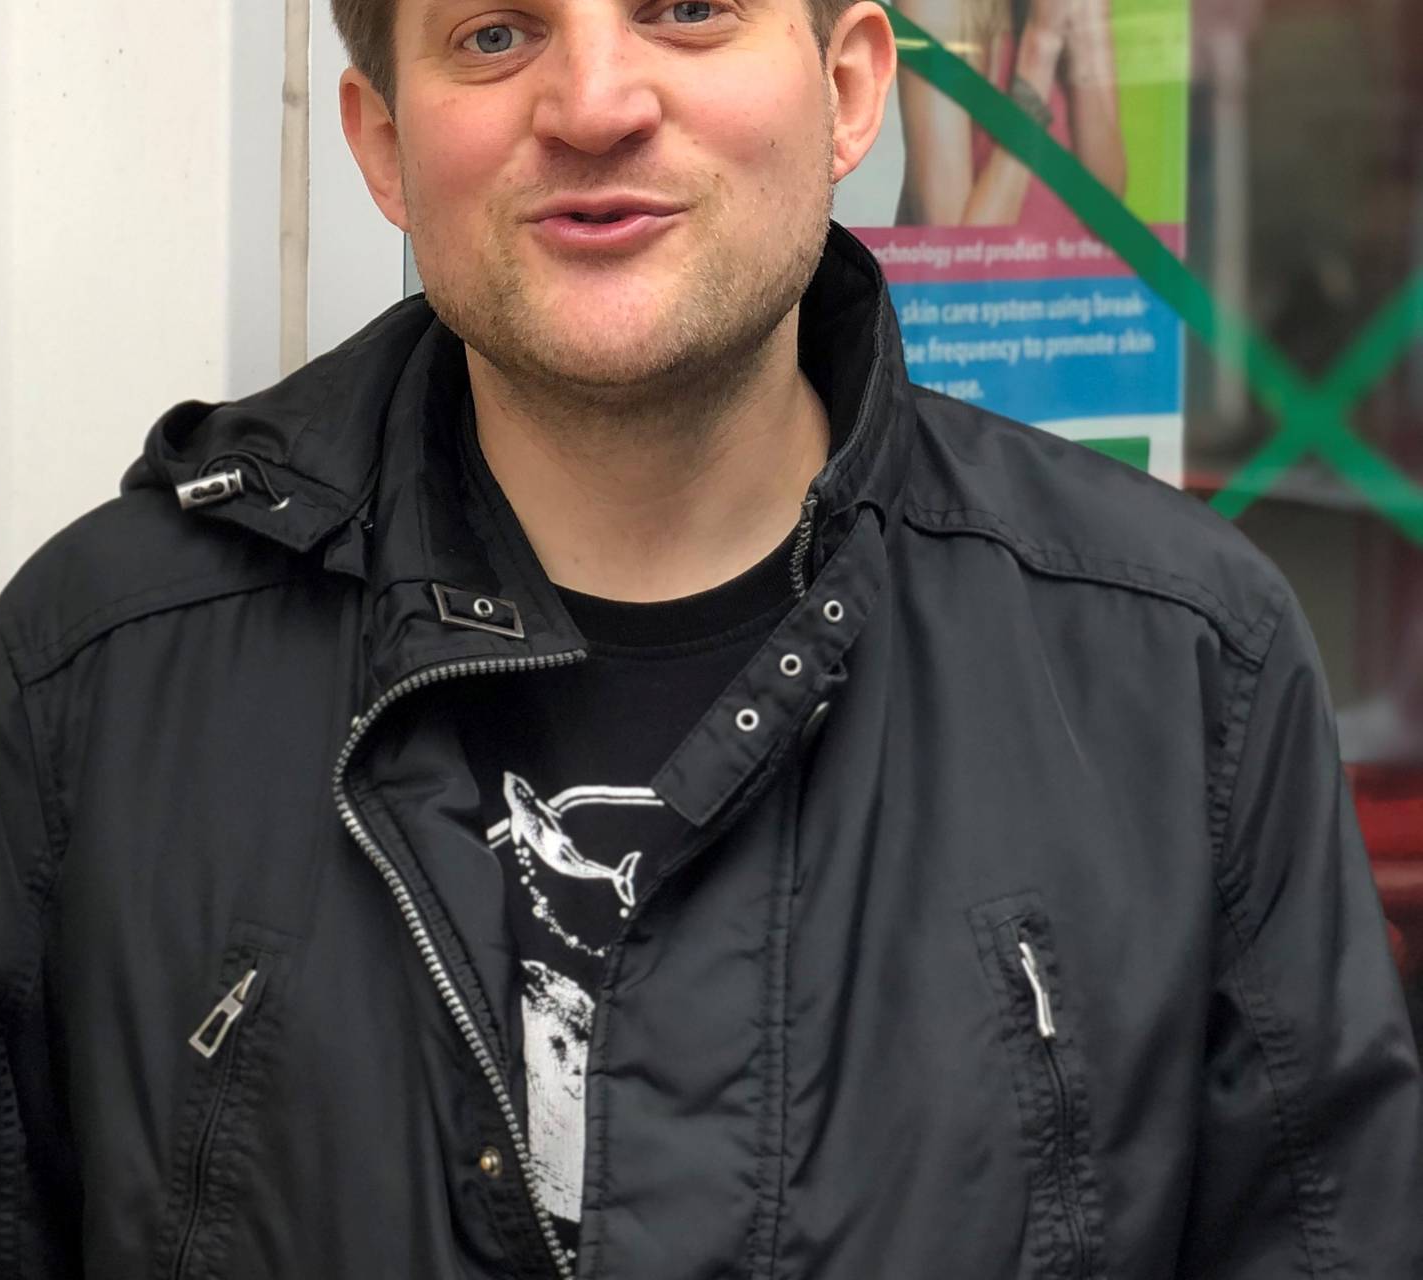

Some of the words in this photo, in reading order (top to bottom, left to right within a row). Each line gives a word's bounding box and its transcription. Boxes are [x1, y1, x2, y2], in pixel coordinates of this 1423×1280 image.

[867, 241, 951, 269] echnology
[955, 240, 984, 262] and
[985, 238, 1047, 268] product
[1078, 236, 1103, 259] the
[901, 299, 939, 325] skin
[941, 303, 979, 324] care
[981, 299, 1044, 328] system
[1048, 292, 1091, 324] using
[928, 336, 1020, 367] frequency
[1023, 335, 1042, 359] to
[1044, 332, 1115, 363] promote
[1118, 329, 1155, 354] skin
